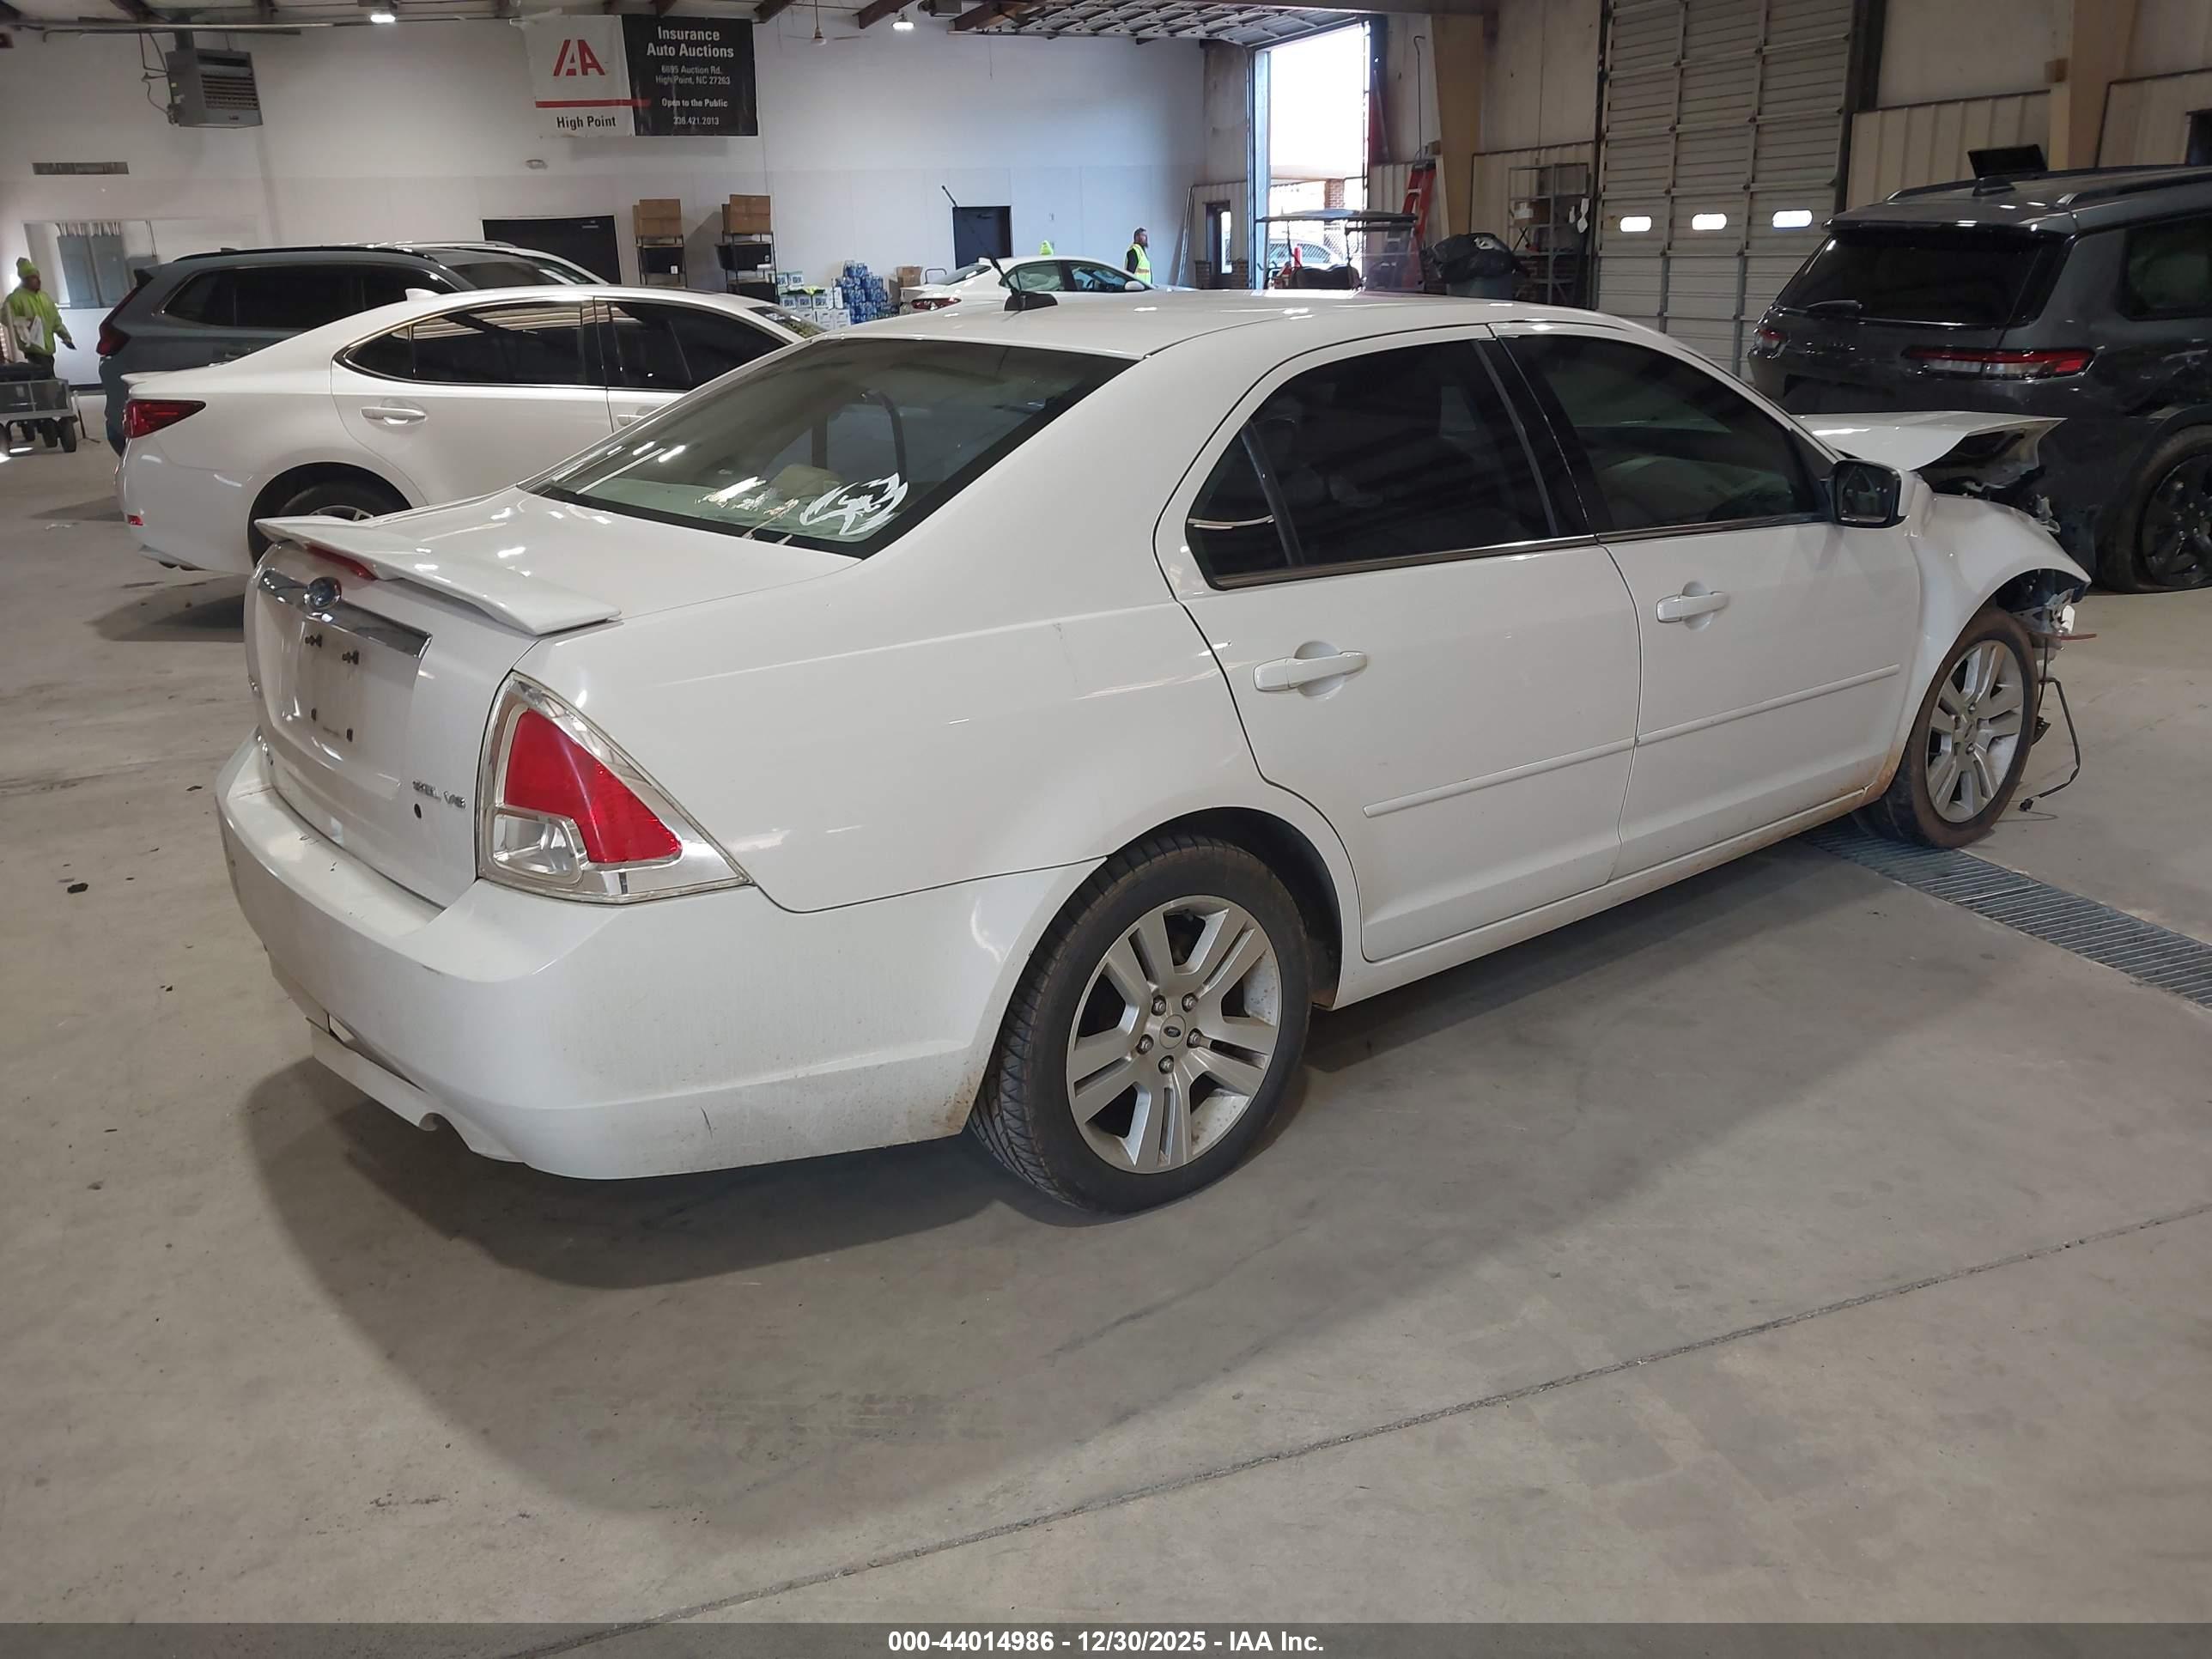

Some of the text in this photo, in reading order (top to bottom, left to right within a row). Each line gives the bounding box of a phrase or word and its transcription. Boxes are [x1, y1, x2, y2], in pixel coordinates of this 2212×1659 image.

[658, 26, 720, 41] Insurance
[647, 42, 734, 58] Auto Auctions
[681, 65, 709, 74] Auction
[656, 76, 674, 85] High
[661, 98, 680, 107] Open
[704, 99, 728, 107] Public
[556, 115, 617, 131] High Point
